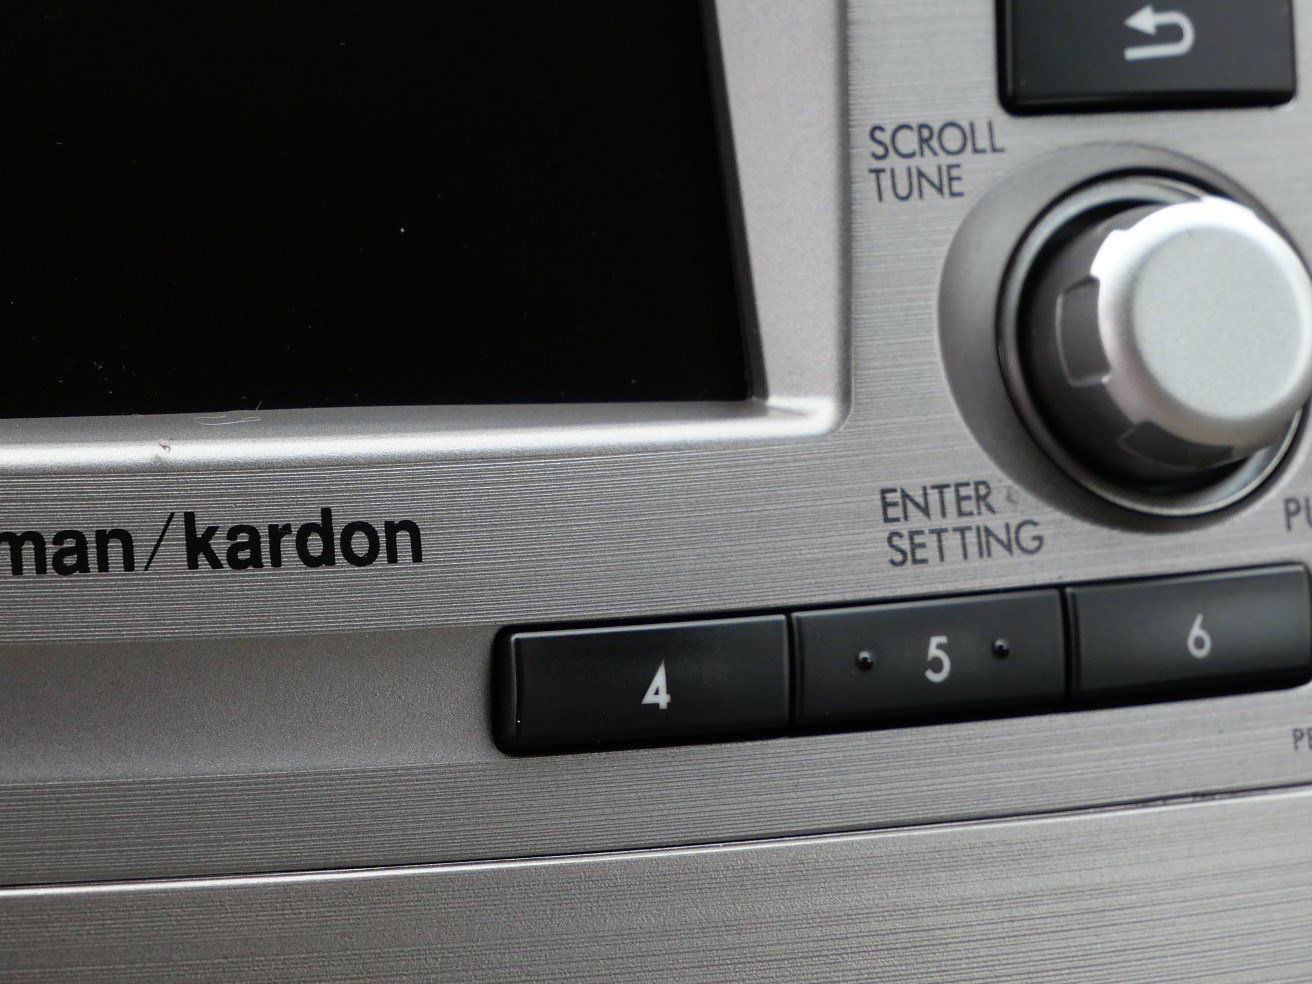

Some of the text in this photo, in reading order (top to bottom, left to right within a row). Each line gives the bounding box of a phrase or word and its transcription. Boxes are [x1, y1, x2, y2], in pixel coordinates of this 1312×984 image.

[868, 121, 1005, 161] SCROLL
[868, 163, 964, 203] TUNE
[880, 480, 996, 523] ENTER
[887, 519, 1044, 567] SETTING
[1187, 614, 1212, 659] 6
[924, 636, 951, 683] 5
[641, 661, 672, 710] 4
